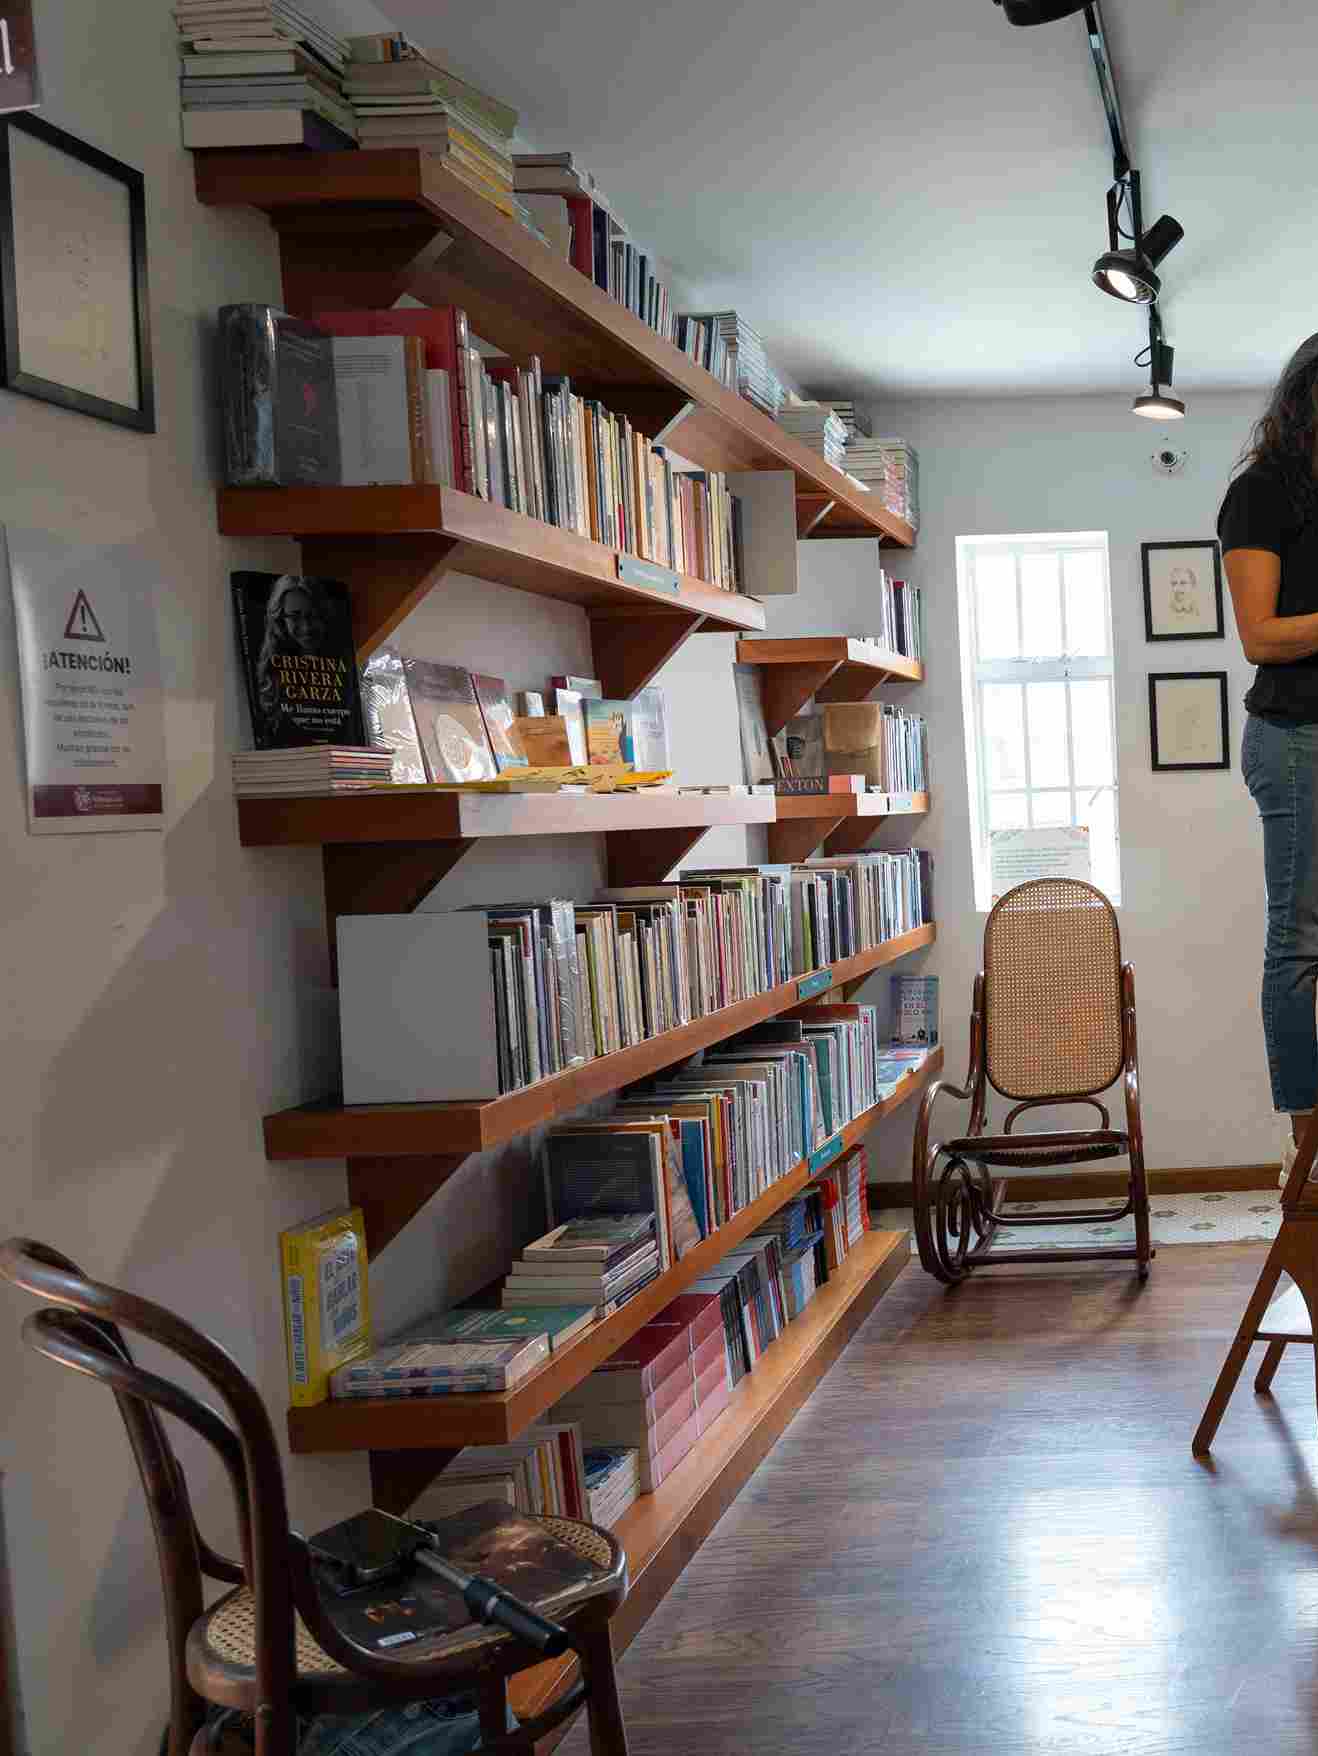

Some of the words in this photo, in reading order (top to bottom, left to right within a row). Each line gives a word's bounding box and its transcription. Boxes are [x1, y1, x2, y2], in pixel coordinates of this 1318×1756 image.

[43, 650, 131, 675] ¡ATENCIÓN!
[271, 655, 346, 673] CRISTINA
[279, 670, 345, 687] RIVERA
[286, 685, 342, 702] GARZA
